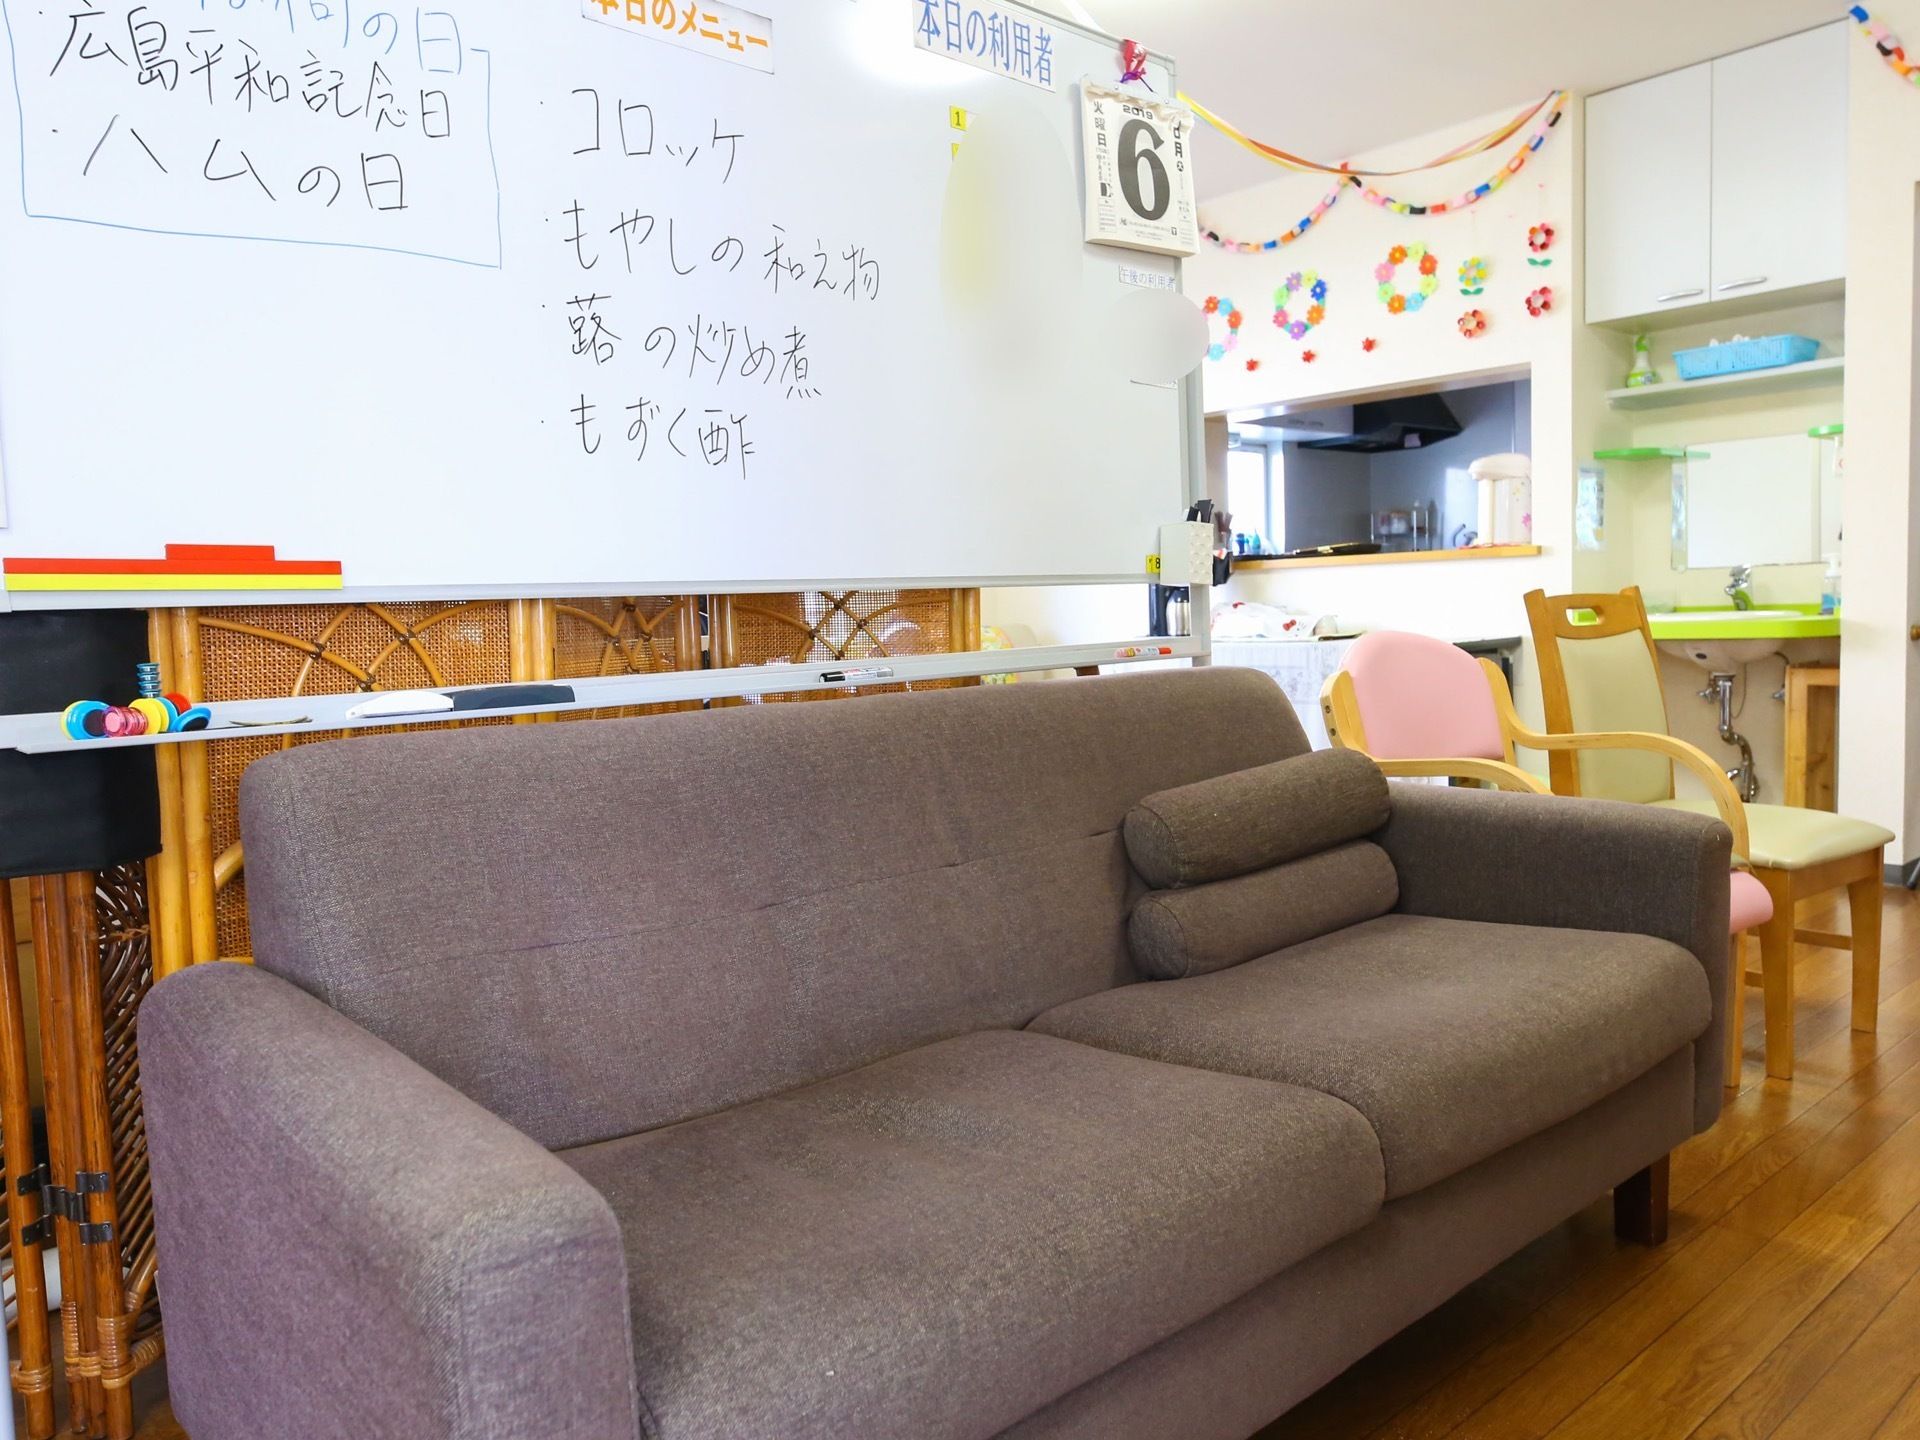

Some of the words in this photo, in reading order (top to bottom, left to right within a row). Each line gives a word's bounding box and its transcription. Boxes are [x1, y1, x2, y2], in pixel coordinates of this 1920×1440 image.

[50, 0, 451, 138] 広島平和記念日
[918, 0, 1053, 86] 本日の利用者
[571, 88, 745, 184] コロッケ
[954, 111, 961, 127] 1
[1122, 104, 1154, 120] 2019
[83, 114, 408, 211] ハムの日
[1117, 118, 1171, 221] 6
[562, 198, 880, 303] もやしの和え物
